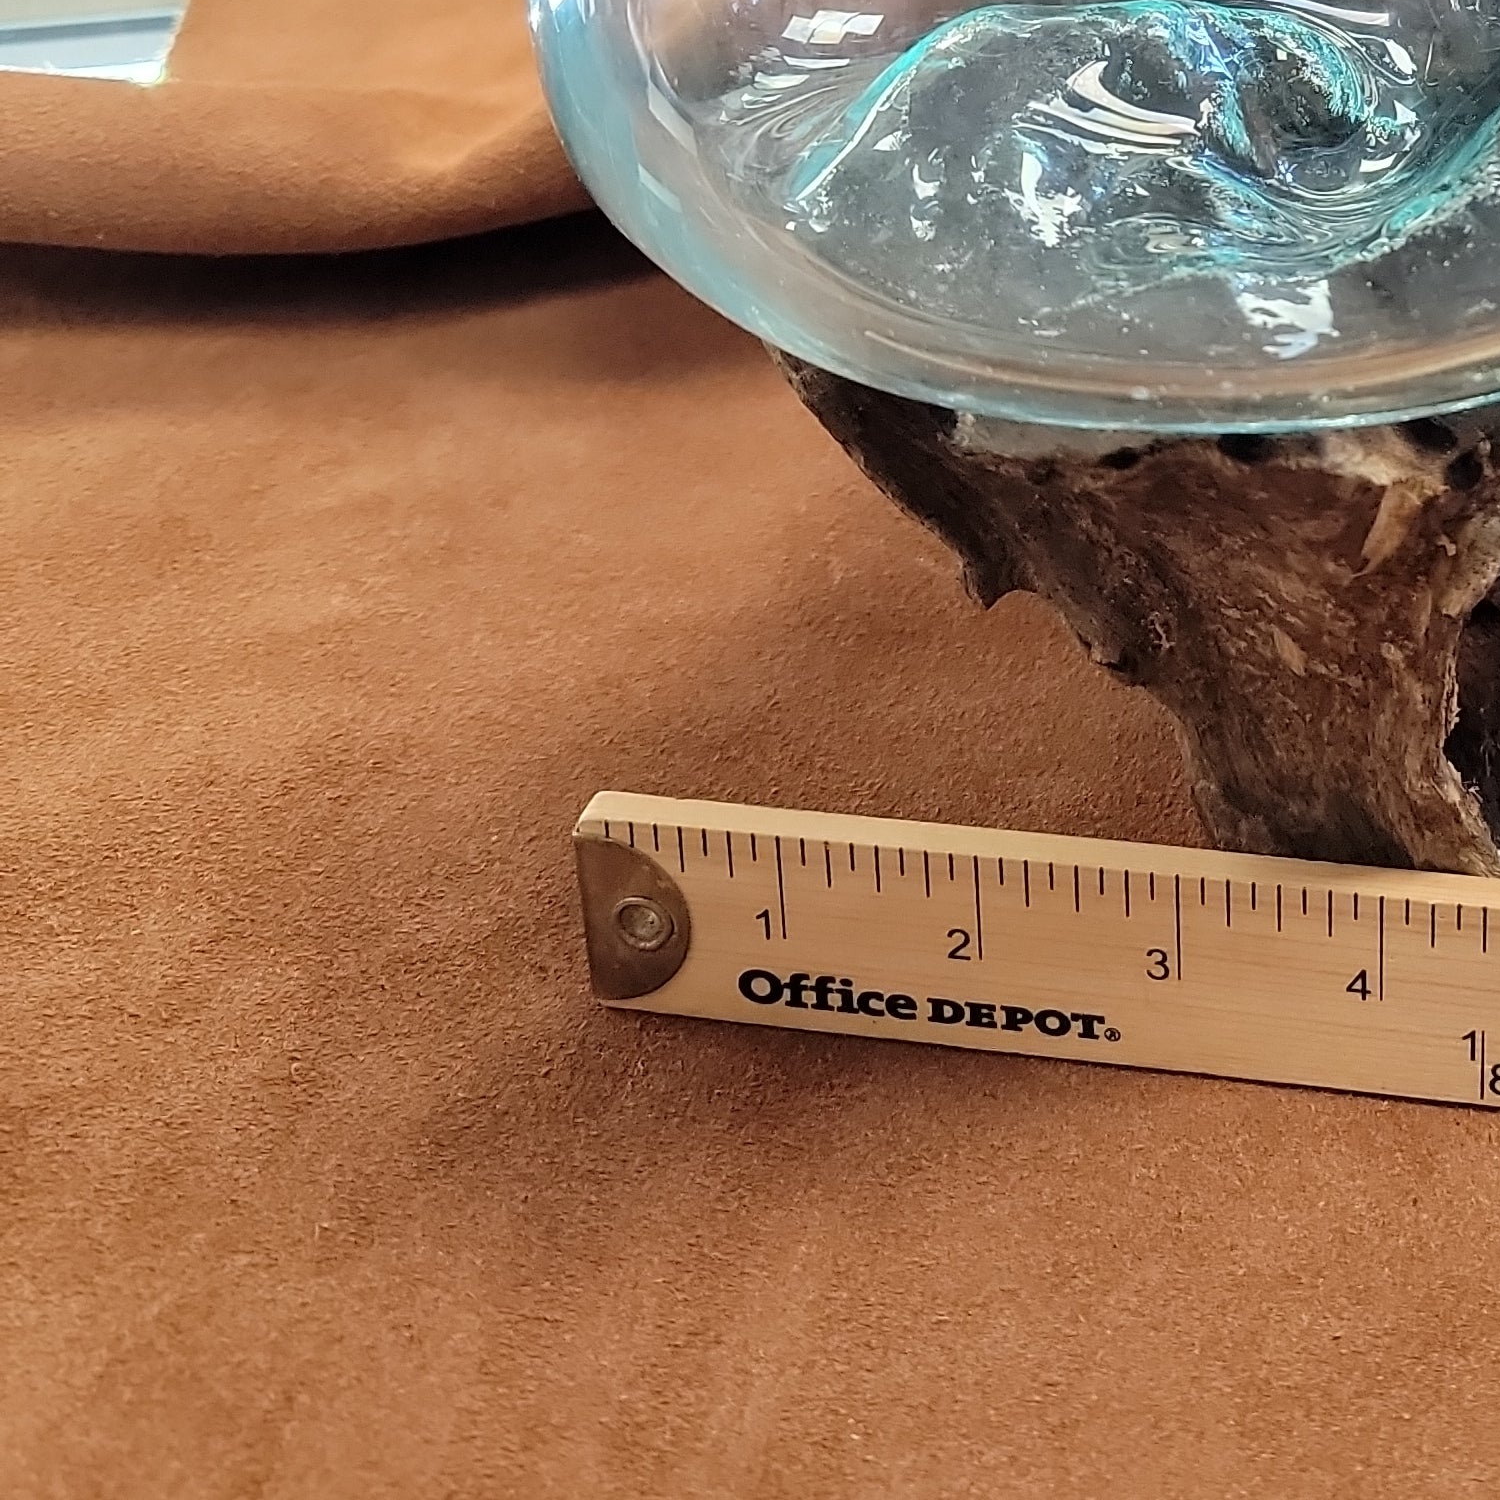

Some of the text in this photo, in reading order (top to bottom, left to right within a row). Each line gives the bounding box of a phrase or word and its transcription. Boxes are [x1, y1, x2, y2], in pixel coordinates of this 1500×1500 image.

[755, 908, 771, 941] 1
[946, 928, 972, 962] 2
[1145, 948, 1170, 981] 3
[1345, 968, 1372, 1002] 4
[737, 968, 918, 1021] Office
